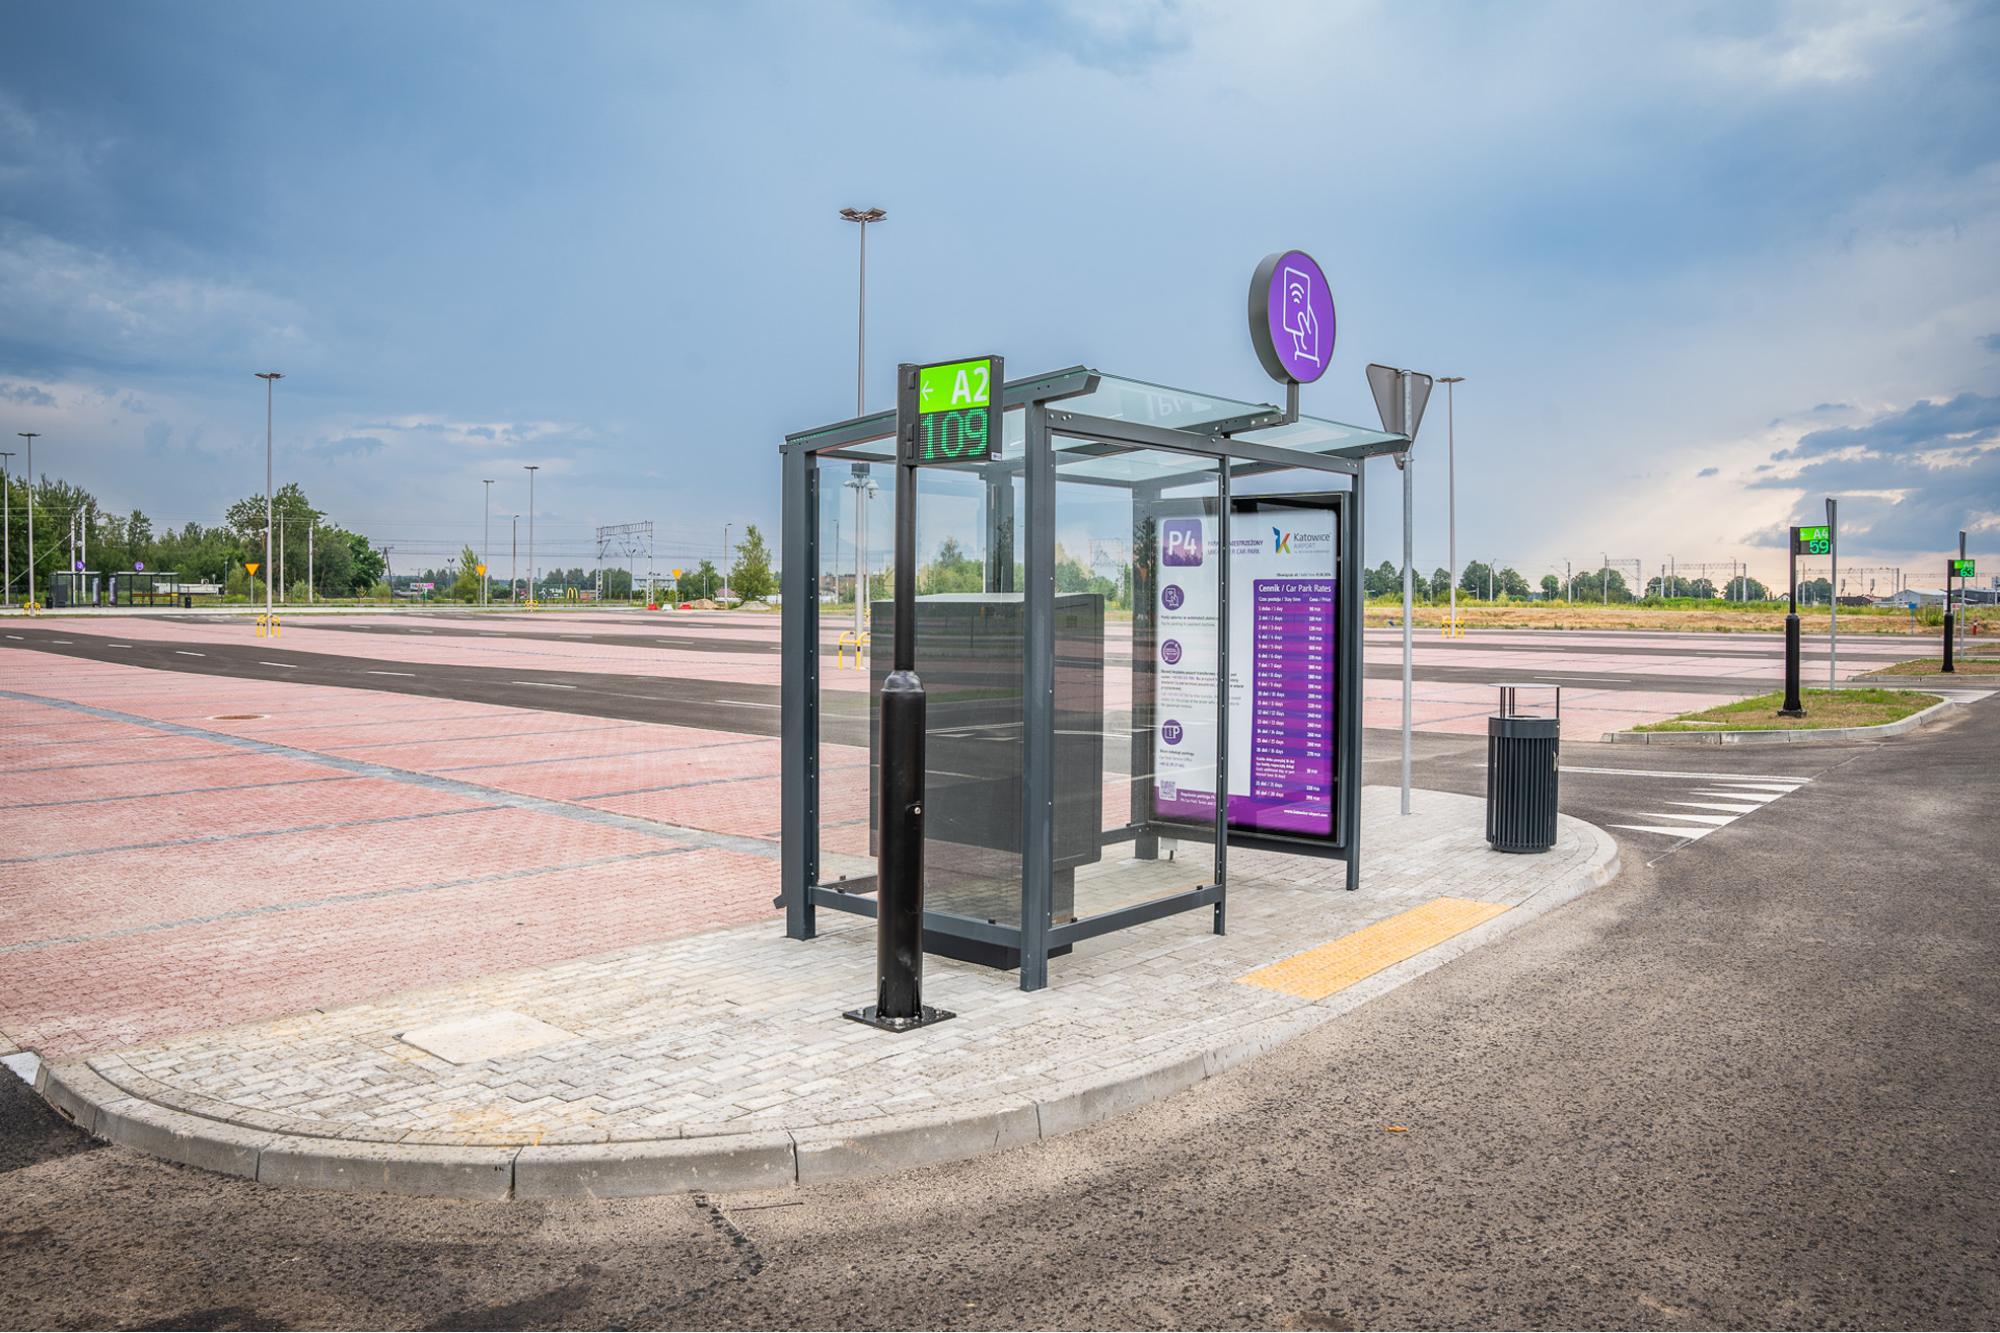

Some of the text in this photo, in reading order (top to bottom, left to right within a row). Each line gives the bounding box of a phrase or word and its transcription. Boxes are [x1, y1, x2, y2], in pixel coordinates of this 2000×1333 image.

[951, 366, 988, 405] A2
[922, 408, 988, 460] 109
[1294, 533, 1330, 542] Katowice
[1814, 528, 1829, 539] A4
[1168, 531, 1197, 556] P4
[1809, 540, 1829, 554] 59
[1960, 568, 1974, 577] 63
[1258, 584, 1280, 592] Cennik
[1286, 584, 1297, 592] Car
[1298, 584, 1312, 592] Park
